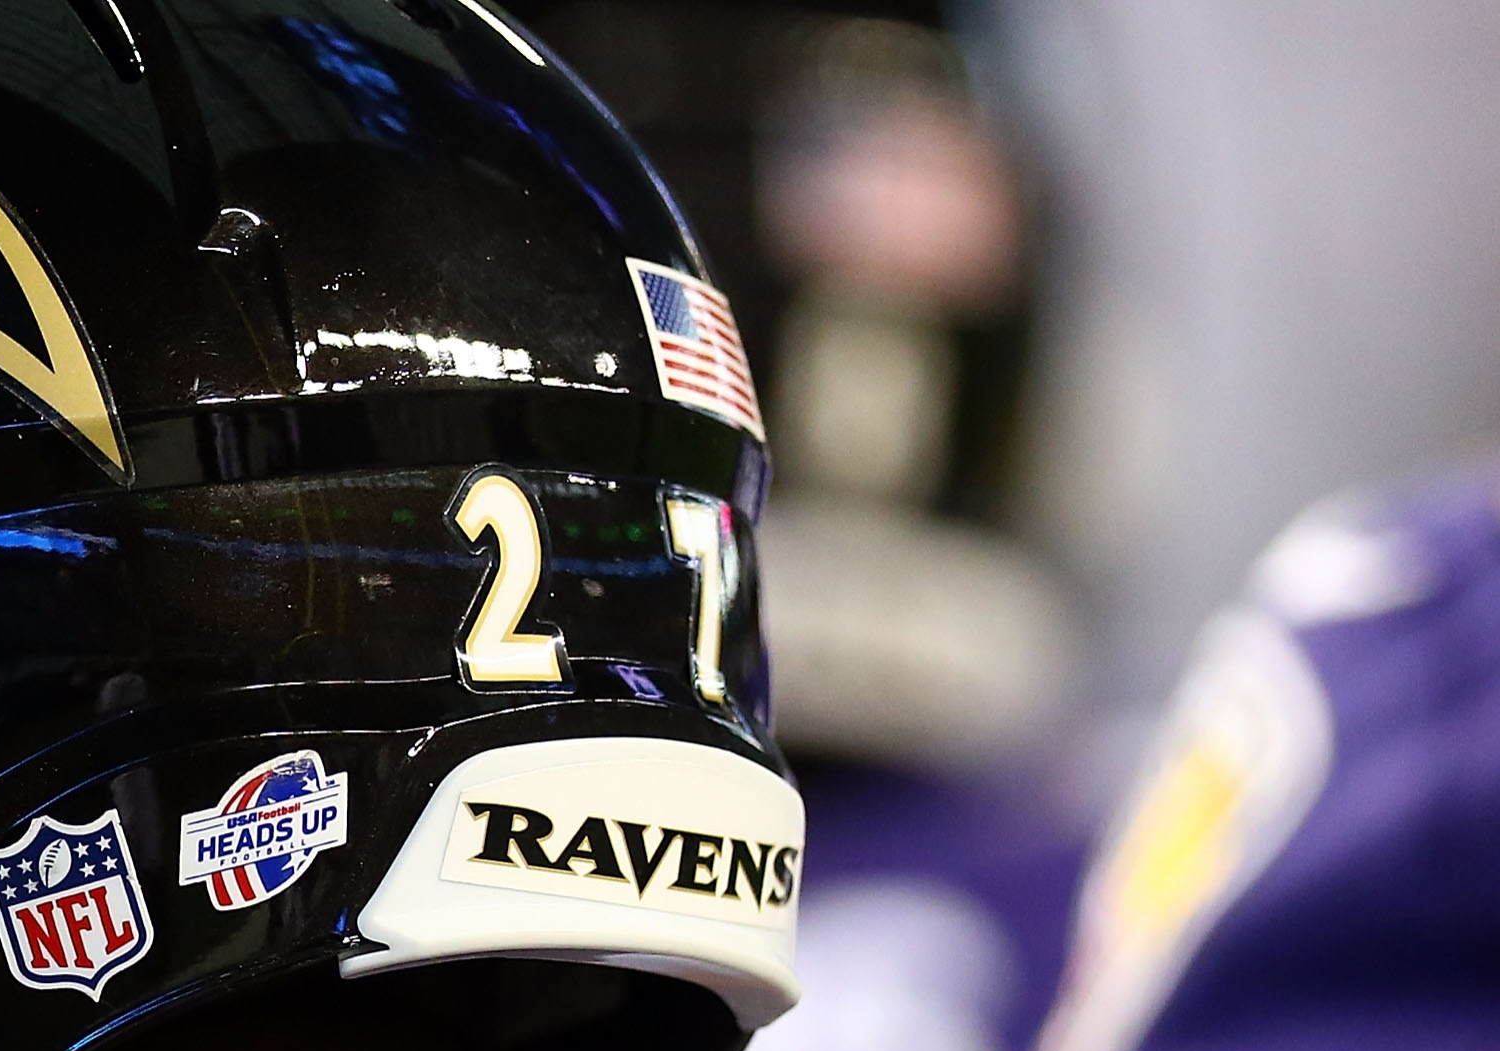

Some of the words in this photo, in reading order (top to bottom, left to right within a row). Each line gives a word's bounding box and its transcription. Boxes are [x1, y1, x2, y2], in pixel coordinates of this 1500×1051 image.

[454, 476, 563, 681] 2
[198, 817, 293, 862] HEADS
[302, 805, 338, 835] UP
[219, 839, 306, 867] FOOTBALL
[462, 801, 799, 913] RAVENS
[16, 885, 135, 970] NFL
